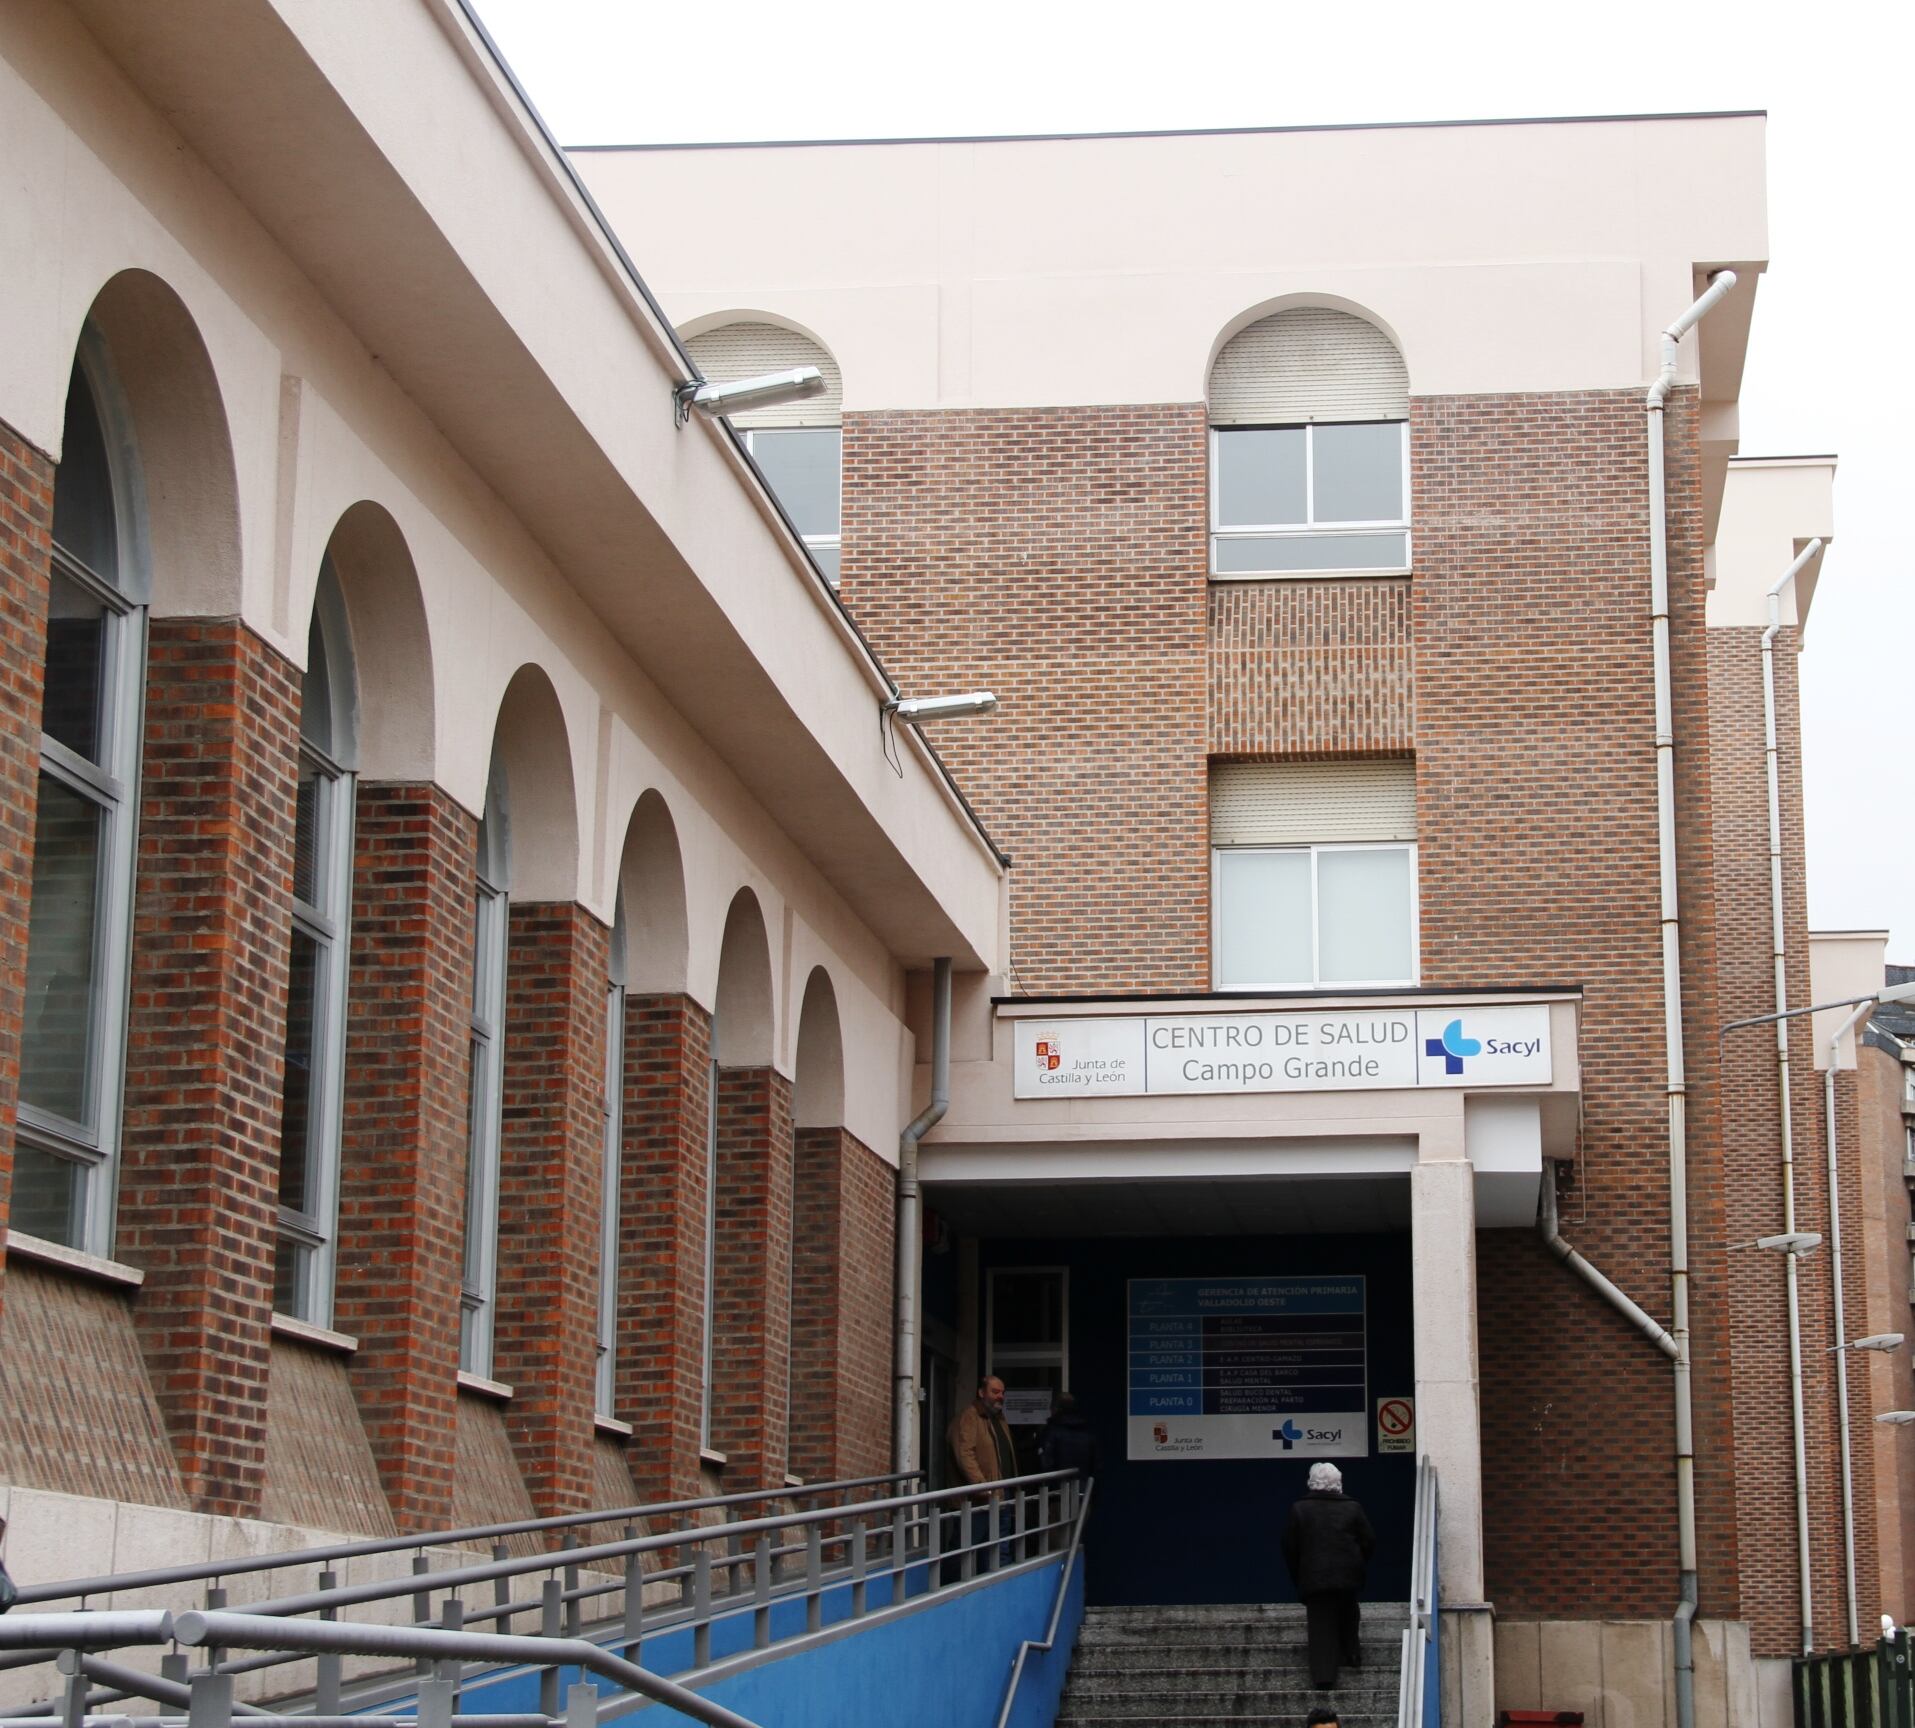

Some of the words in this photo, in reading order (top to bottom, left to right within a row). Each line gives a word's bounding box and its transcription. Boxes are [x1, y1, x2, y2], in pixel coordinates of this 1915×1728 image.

[1152, 1025, 1263, 1049] CENTRO
[1275, 1024, 1309, 1046] DE
[1320, 1021, 1409, 1045] SALUD
[1486, 1038, 1540, 1057] Sacyl
[1072, 1059, 1106, 1070] Junta
[1110, 1058, 1126, 1069] de
[1182, 1059, 1273, 1085] Campo
[1284, 1055, 1379, 1079] Grande
[1040, 1072, 1081, 1084] Castilla
[1085, 1073, 1092, 1085] y
[1096, 1070, 1126, 1082] León
[1198, 1287, 1244, 1296] GERENCIA
[1247, 1287, 1259, 1296] DE
[1261, 1286, 1308, 1295] ATENCIÓN
[1310, 1286, 1358, 1295] PRIMARIA
[1257, 1297, 1286, 1306] OESTE
[1149, 1355, 1185, 1364] PLANTA
[1149, 1374, 1185, 1383] PLANTA
[1187, 1374, 1193, 1383] 1
[1149, 1397, 1185, 1406] PLANTA
[1187, 1397, 1193, 1406] 0
[1306, 1429, 1342, 1442] Sacyl
[1155, 1444, 1179, 1452] Castilla
[1186, 1443, 1204, 1451] León
